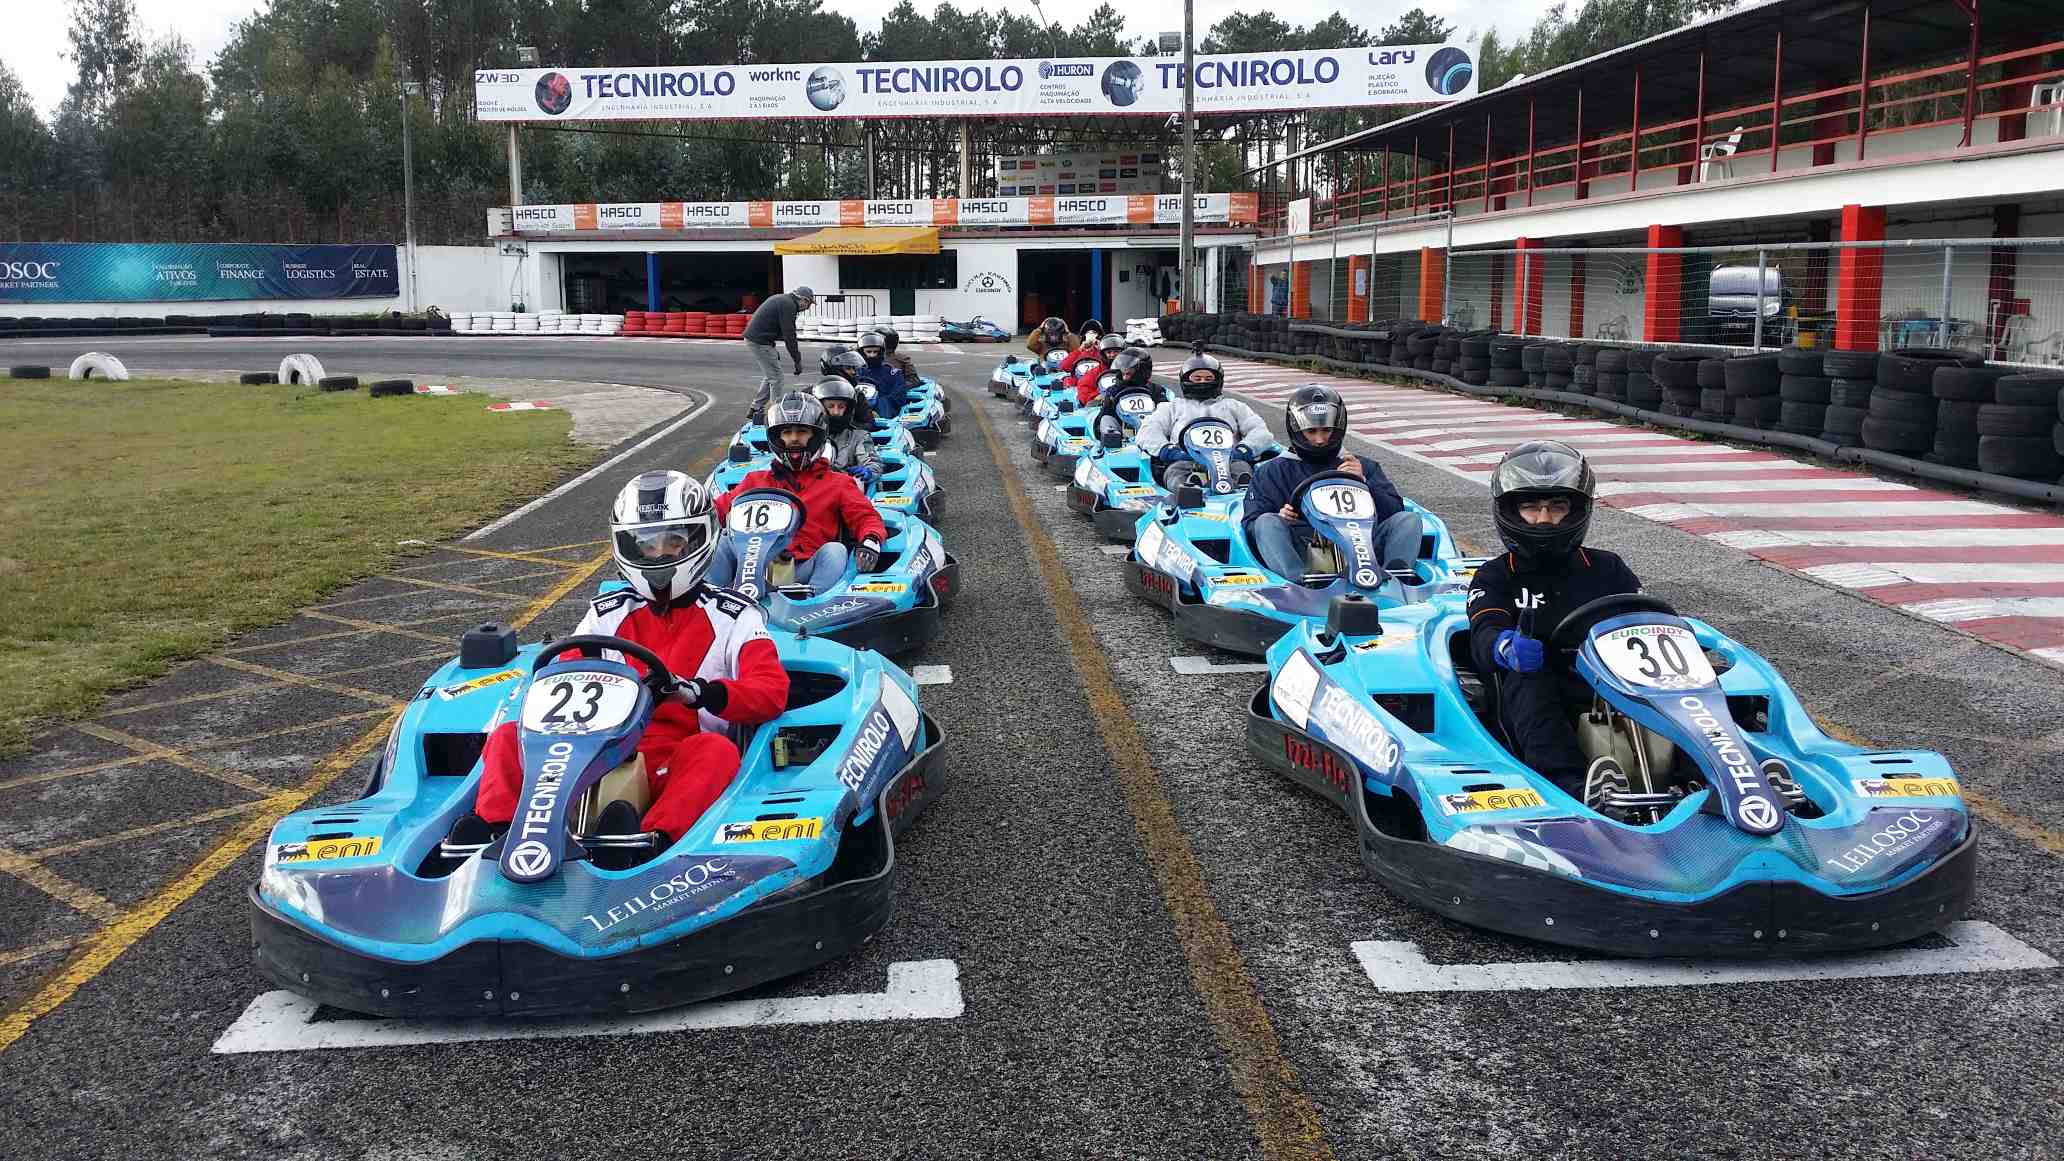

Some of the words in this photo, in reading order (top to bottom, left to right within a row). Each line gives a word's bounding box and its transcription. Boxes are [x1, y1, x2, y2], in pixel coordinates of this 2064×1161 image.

[748, 67, 801, 82] worknc
[1057, 66, 1091, 75] HURON
[1155, 56, 1340, 89] TECNIROLO
[580, 71, 736, 98] TECNIROLO
[855, 65, 1024, 93] TECNIROLO
[600, 207, 641, 218] HASCO
[687, 206, 730, 217] HASCO
[776, 204, 821, 216] HASCO
[867, 203, 913, 214] HASCO
[962, 202, 1008, 213] HASCO
[1058, 200, 1106, 211] HASCO
[515, 208, 556, 220] HASCO
[156, 270, 197, 281] ATIVOS
[220, 269, 265, 279] FINANCE
[286, 269, 336, 280] LOGISTICS
[355, 269, 389, 279] ESTATE
[1129, 399, 1145, 411] 20
[1201, 429, 1224, 445] 26
[1329, 489, 1356, 513] 19
[743, 504, 770, 528] 16
[791, 597, 866, 625] LEILOSOC
[1611, 626, 1684, 640] EUROINDY
[1626, 634, 1690, 678] 30
[543, 674, 625, 686] EUROINDY
[540, 681, 604, 724] 23
[1319, 684, 1399, 768] TECNIROLO
[1903, 782, 1958, 796] eni
[1488, 792, 1541, 810] eni
[761, 821, 815, 841] eni
[1827, 809, 1933, 874] LEILOSOC
[316, 838, 376, 861] eni
[584, 857, 730, 932] LEILOSOC
